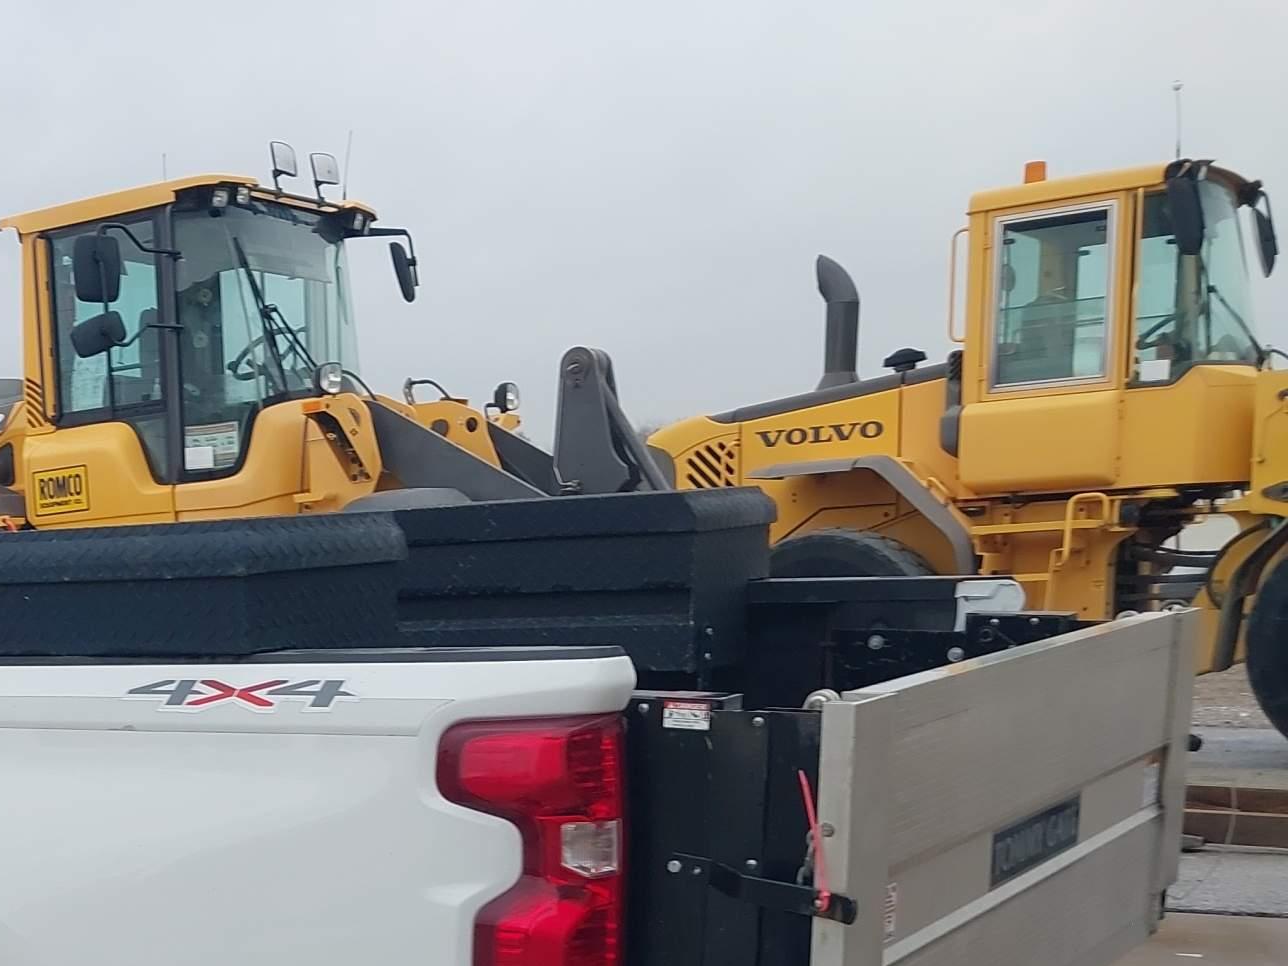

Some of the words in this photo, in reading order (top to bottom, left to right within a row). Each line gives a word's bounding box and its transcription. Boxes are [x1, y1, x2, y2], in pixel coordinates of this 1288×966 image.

[755, 421, 884, 448] VOLVO
[40, 474, 82, 500] ROMCO
[128, 680, 357, 707] 4X4
